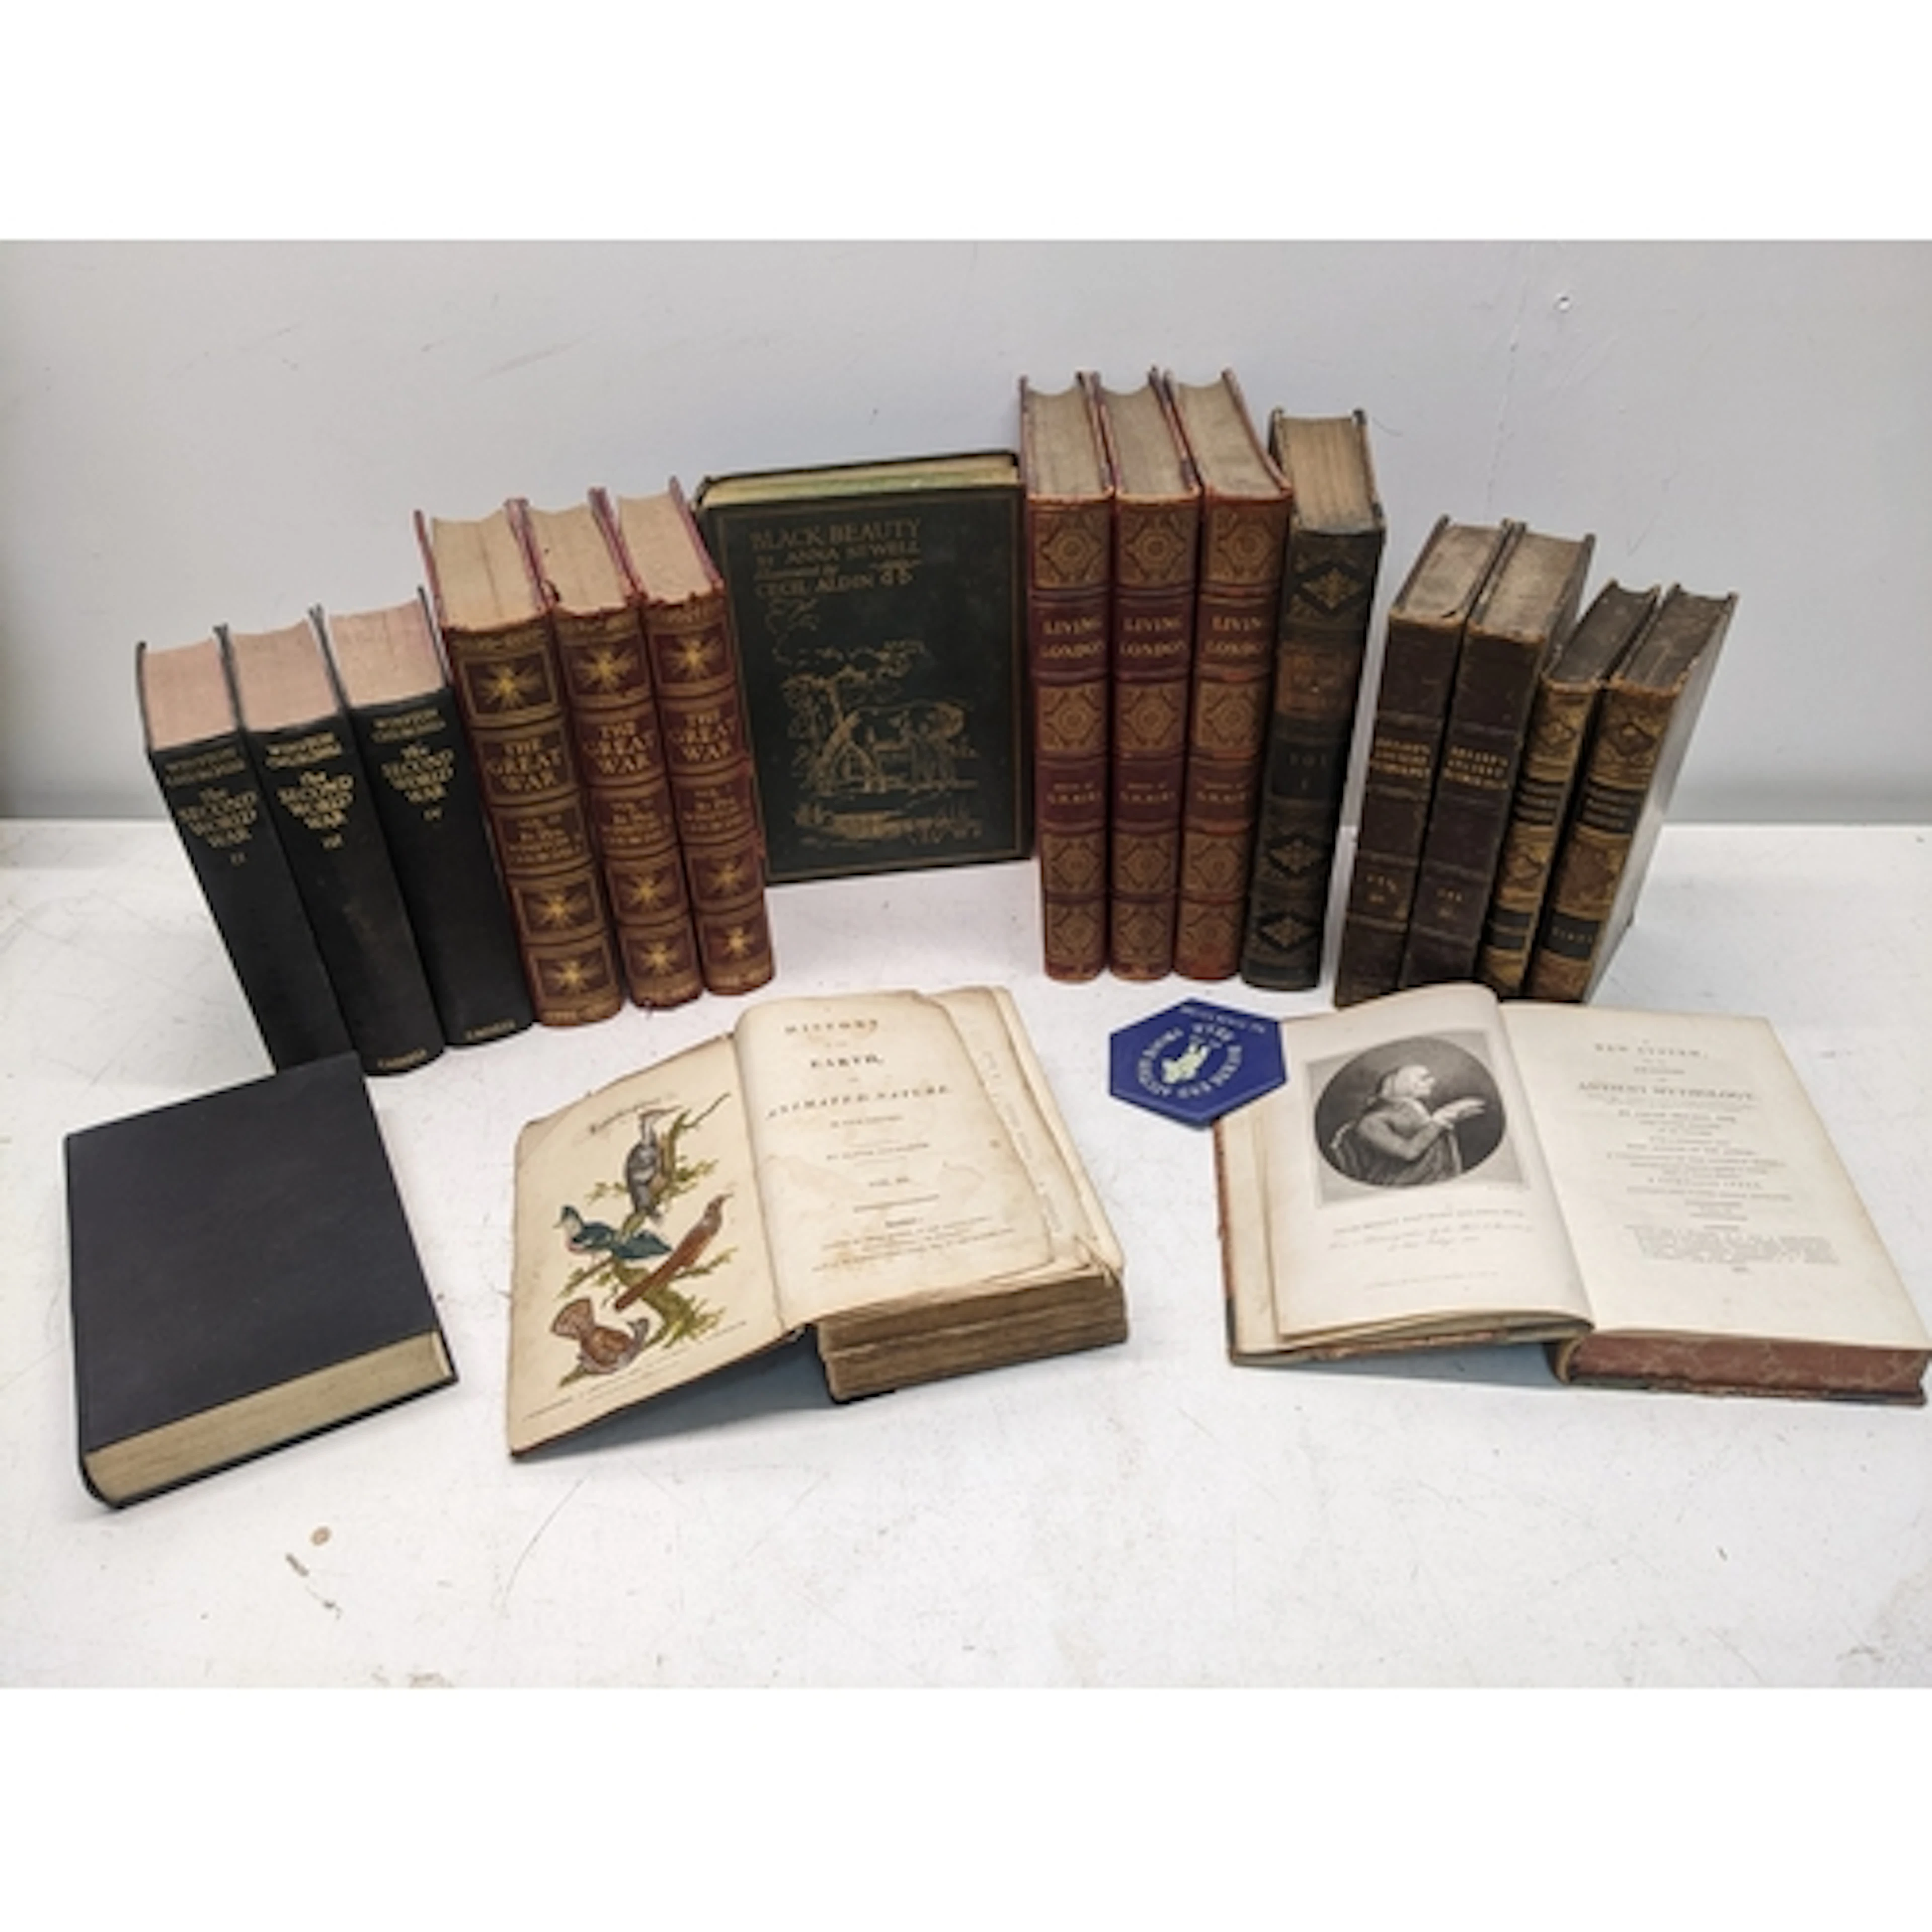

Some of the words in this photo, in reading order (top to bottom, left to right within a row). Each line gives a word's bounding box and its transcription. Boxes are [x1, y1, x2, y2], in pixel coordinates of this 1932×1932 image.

[749, 525, 825, 552] BLACK
[829, 517, 921, 544] BEAUTY
[784, 547, 841, 566] ANNA
[1043, 616, 1102, 635] LIVING
[1123, 616, 1182, 632] LIVING
[1039, 640, 1105, 658] LONDON
[1119, 639, 1186, 658] LONDON
[686, 708, 720, 726] THE
[600, 721, 636, 739] THE
[667, 718, 736, 746] GREAT
[505, 736, 543, 756] THE
[583, 731, 656, 758] GREAT
[683, 741, 732, 762] WAR
[485, 746, 562, 776] GREAT
[597, 753, 651, 774] WAR
[501, 772, 558, 792] WAR
[784, 1019, 878, 1035] HISTORY
